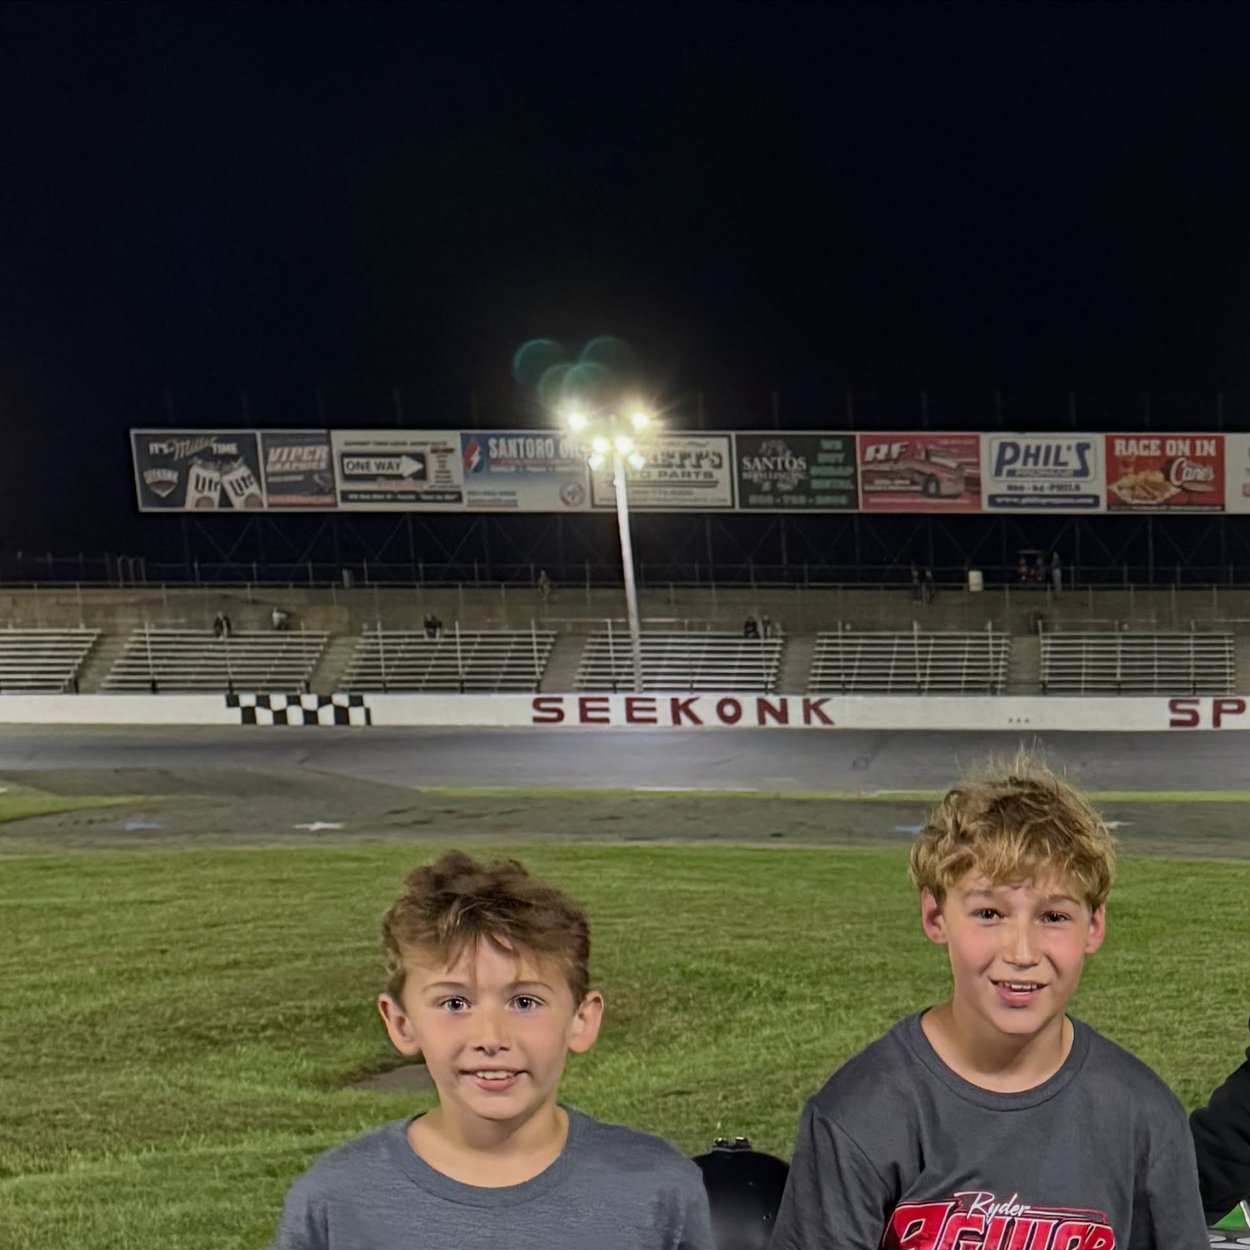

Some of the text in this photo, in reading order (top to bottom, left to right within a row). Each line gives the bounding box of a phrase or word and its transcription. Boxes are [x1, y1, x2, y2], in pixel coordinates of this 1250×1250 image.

[268, 445, 329, 463] VIPER
[489, 437, 555, 459] SANTORO
[1114, 438, 1217, 457] RACE ON IN
[346, 460, 403, 472] ONE WAY
[742, 455, 808, 471] SANTOS
[992, 441, 1092, 479] PHIL'S
[658, 470, 715, 480] PARTS
[531, 696, 834, 726] SEEKONK
